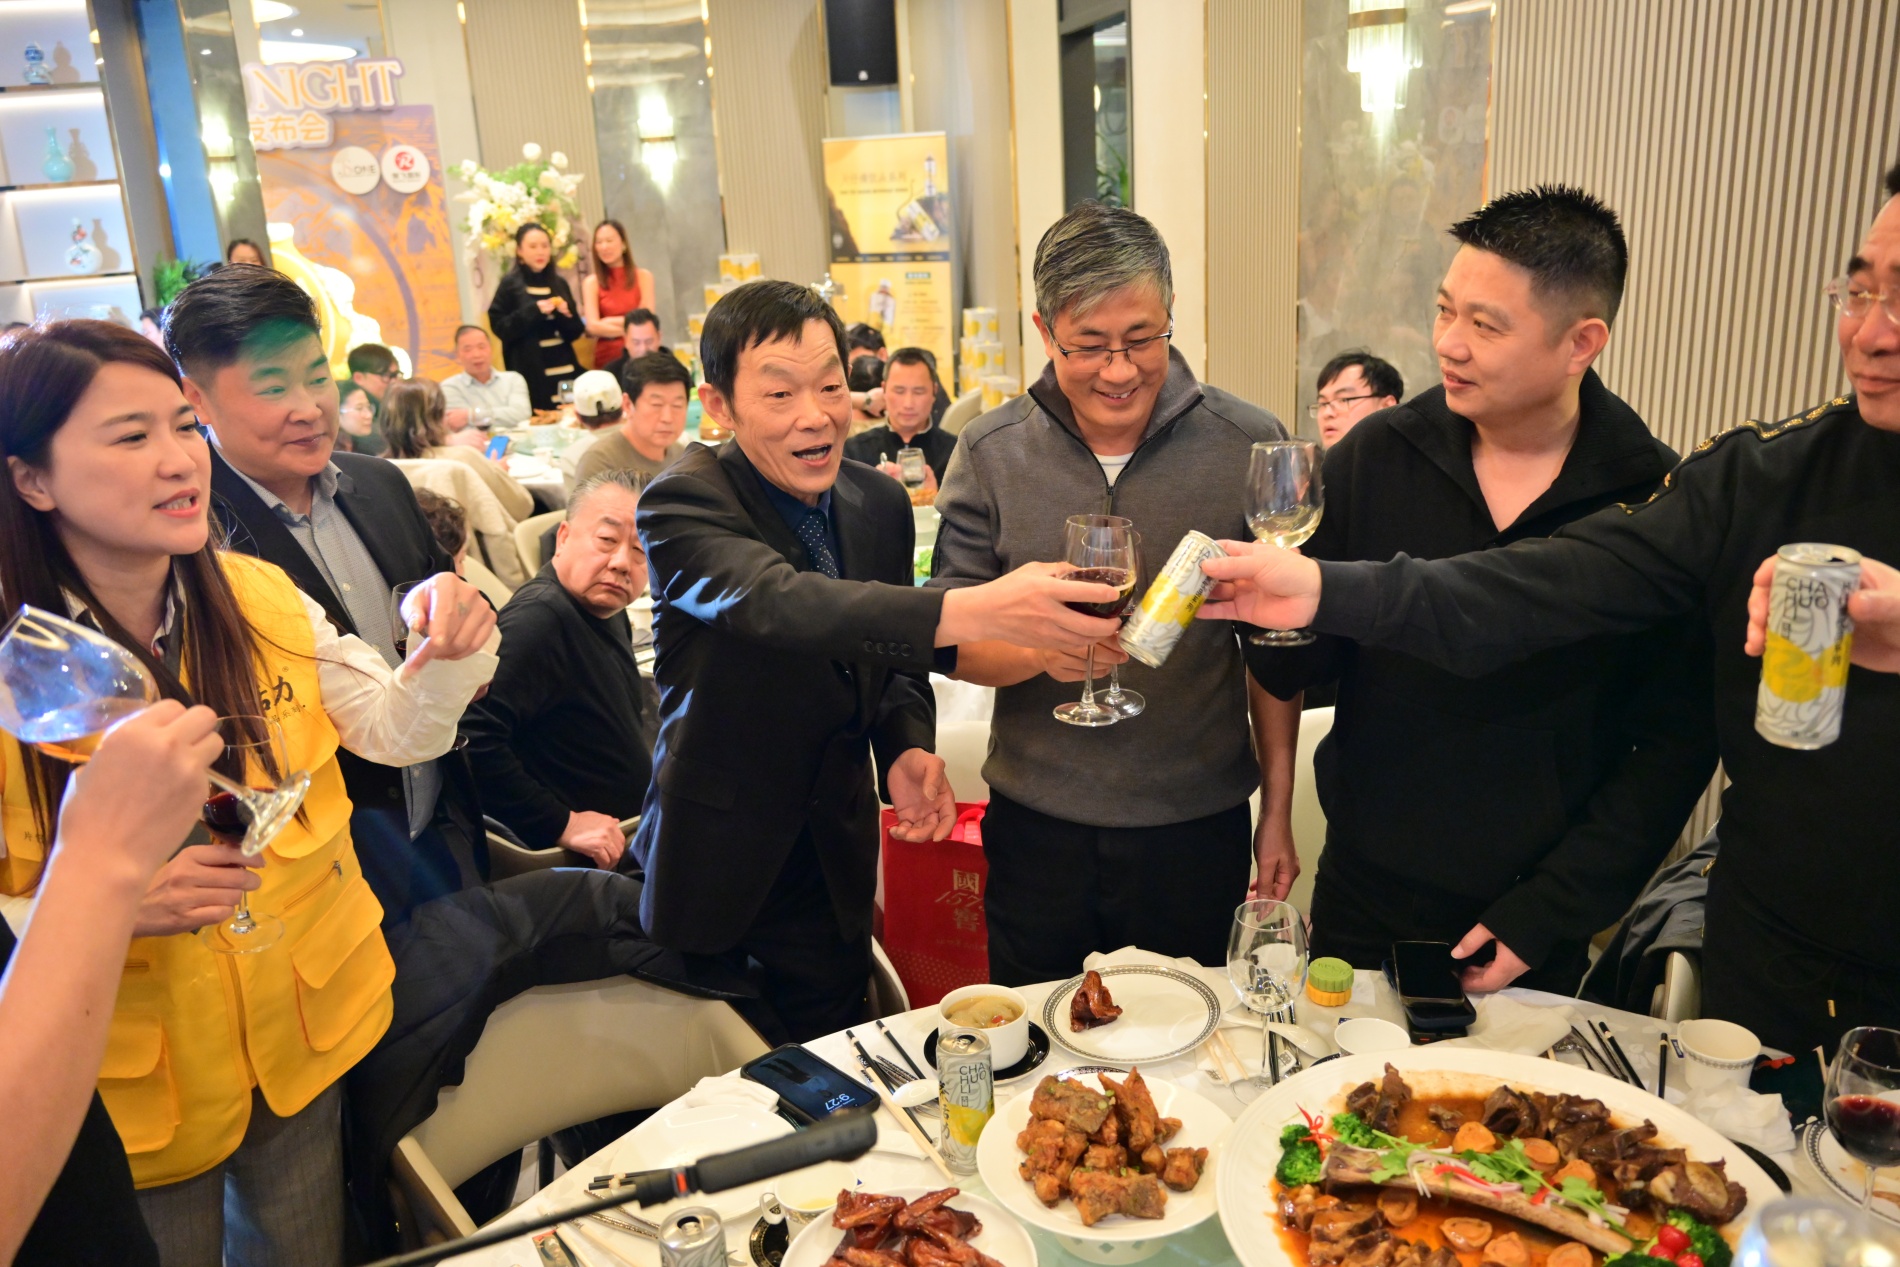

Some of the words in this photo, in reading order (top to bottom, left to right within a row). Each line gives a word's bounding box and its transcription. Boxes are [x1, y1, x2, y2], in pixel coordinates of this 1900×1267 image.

[251, 61, 402, 109] NIGHT
[959, 1062, 986, 1076] CHA
[959, 1070, 987, 1085] HUO
[960, 1084, 971, 1094] LI
[825, 1093, 850, 1111] 9:27
